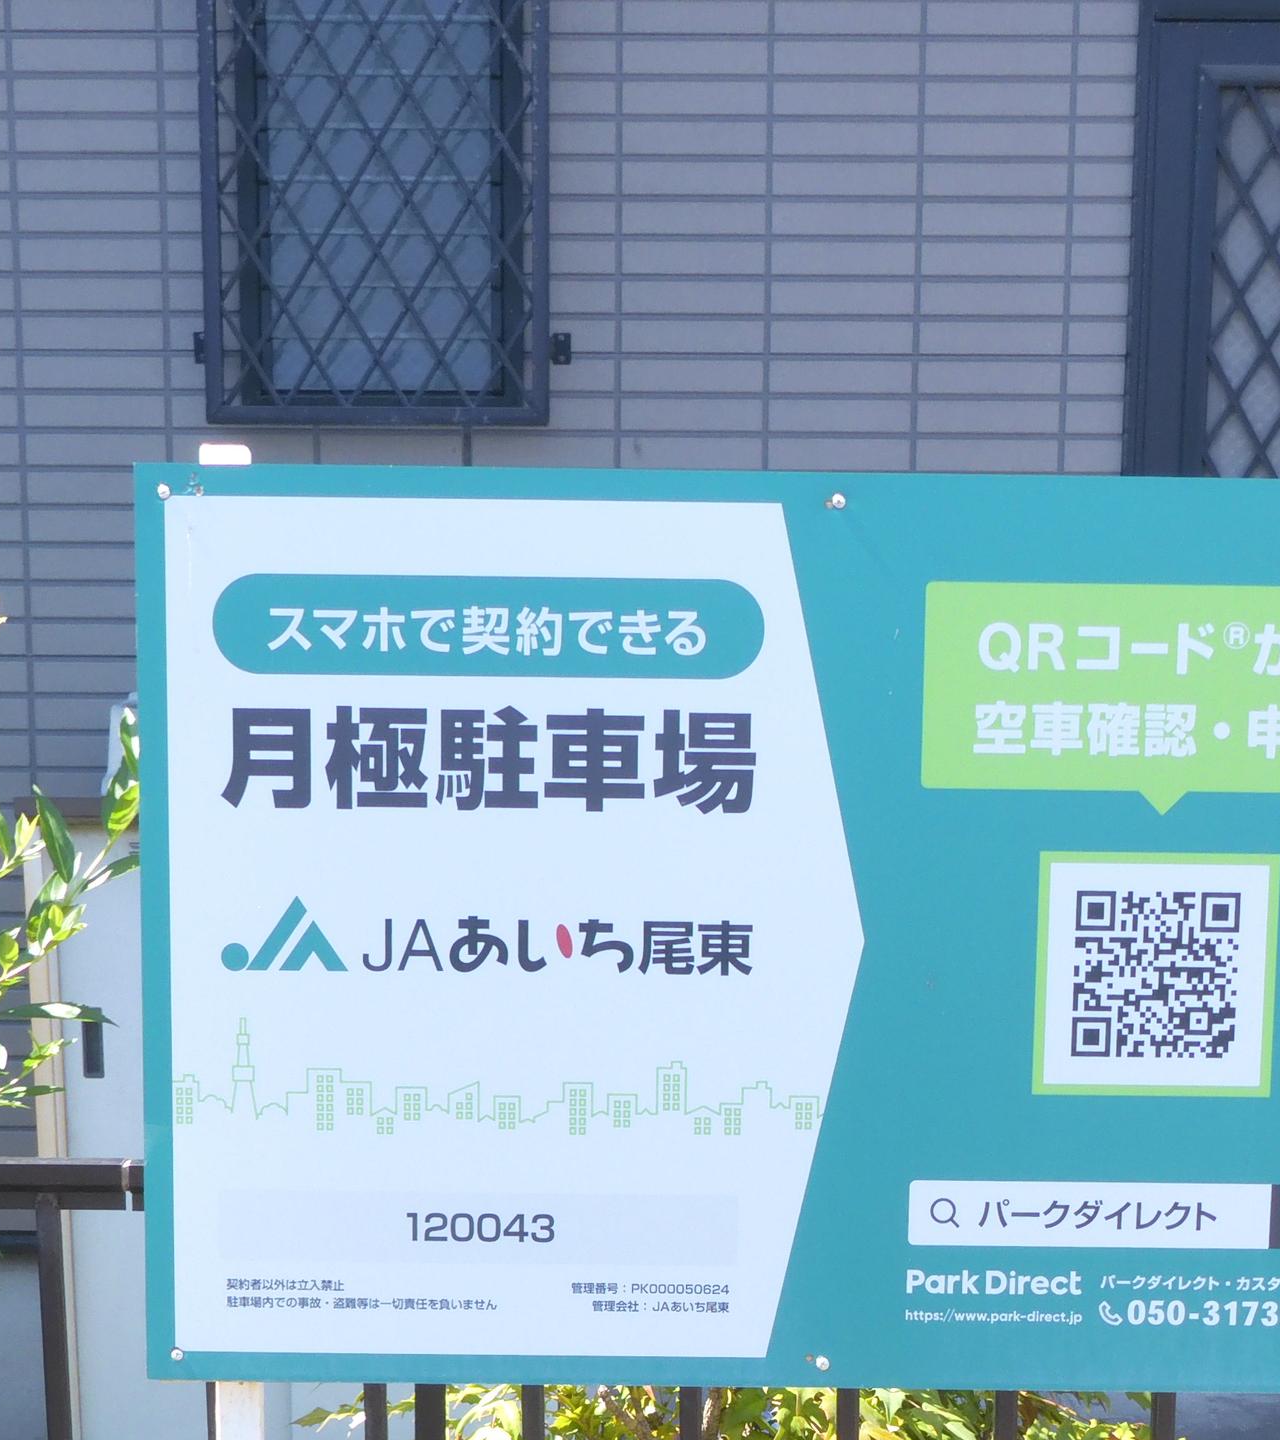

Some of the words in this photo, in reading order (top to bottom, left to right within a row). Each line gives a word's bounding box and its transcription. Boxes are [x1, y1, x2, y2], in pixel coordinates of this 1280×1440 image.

[267, 605, 708, 657] スマホで契約できる
[221, 704, 757, 815] 月極駐車場
[362, 915, 754, 977] JAあいち尾東
[406, 1211, 556, 1243] 120043
[978, 1198, 1218, 1232] パークダイレクト
[225, 1278, 345, 1292] 契約者以外は立入禁止
[905, 1268, 980, 1296] Park
[984, 1270, 1083, 1297] Direct
[904, 1308, 1083, 1326] https://www.park-direct.jp
